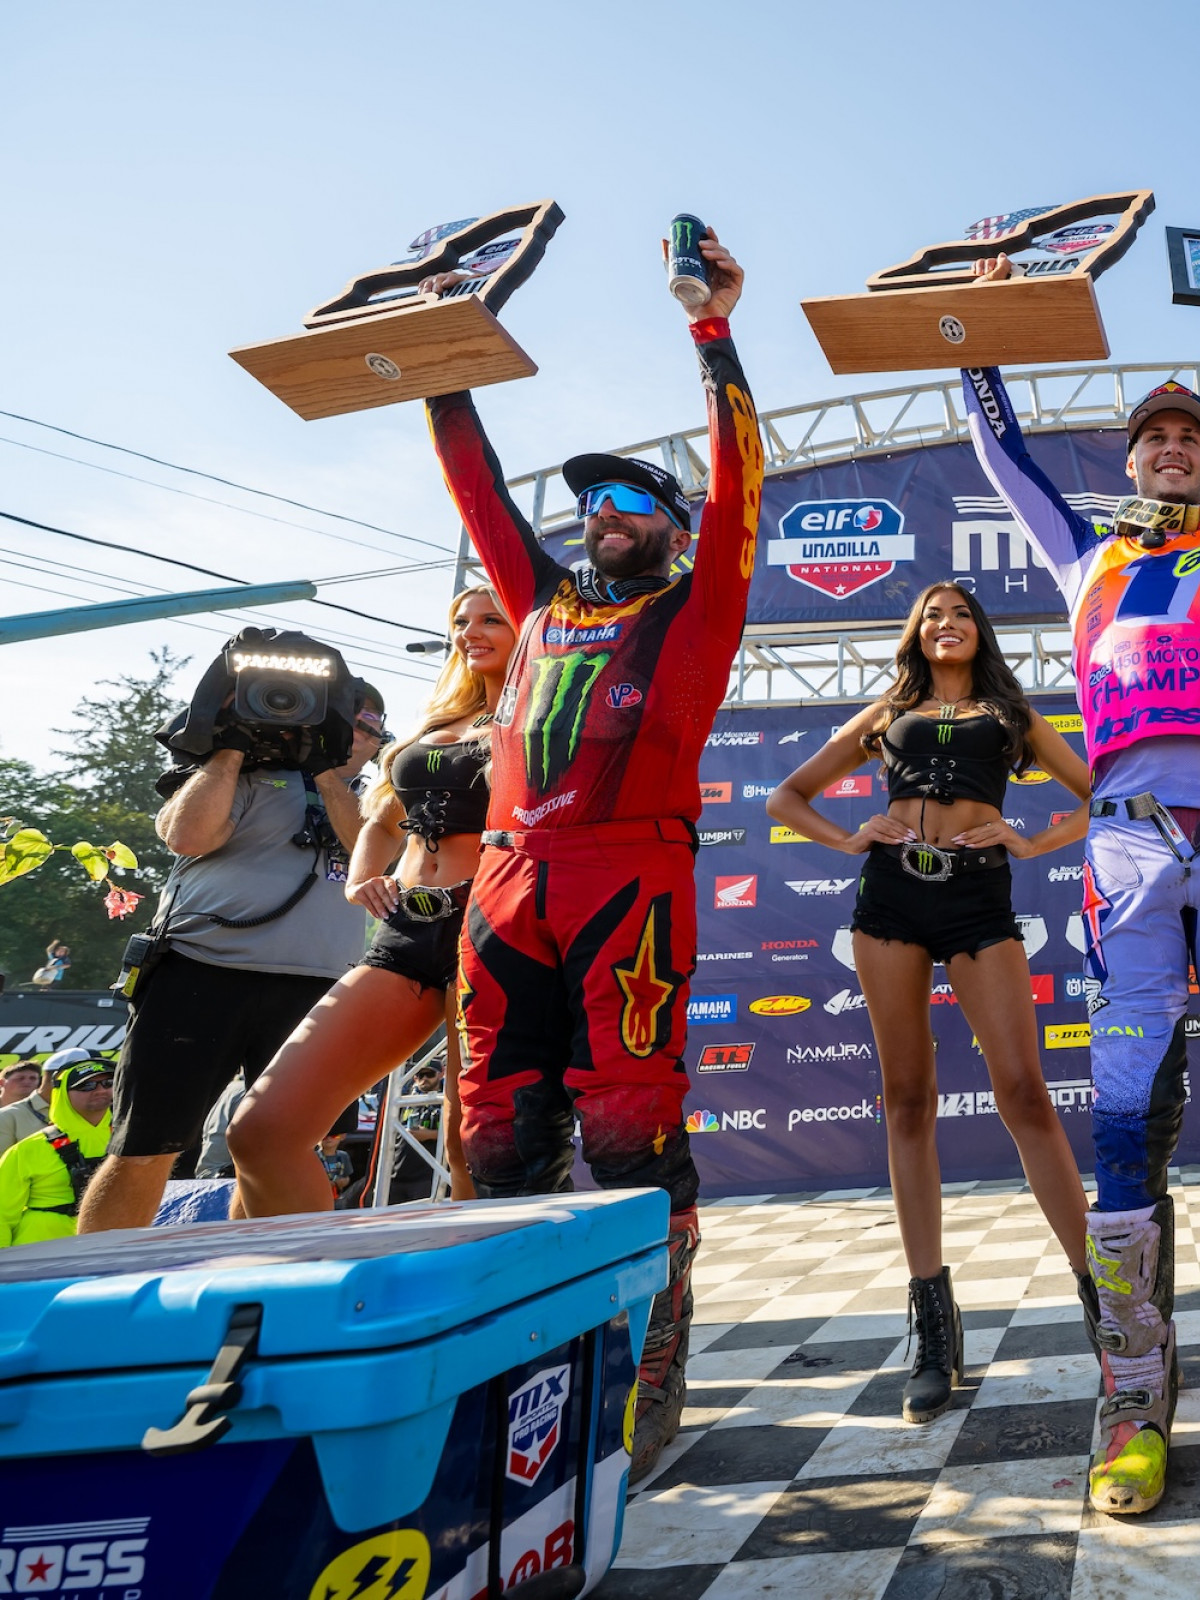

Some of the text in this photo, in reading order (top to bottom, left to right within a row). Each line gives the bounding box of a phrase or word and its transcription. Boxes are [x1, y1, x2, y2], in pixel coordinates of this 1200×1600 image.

[968, 368, 1006, 439] ONDA
[801, 509, 852, 531] elf
[802, 541, 880, 558] UNADILLA
[801, 564, 882, 574] NATIONAL
[561, 626, 617, 642] YAMAHA
[1089, 662, 1113, 688] 2025
[1115, 652, 1142, 671] 450
[723, 731, 760, 739] MOUNTAIN
[512, 790, 579, 828] PROGRESSIVE
[797, 879, 856, 892] FLY
[761, 939, 819, 950] HONDA
[697, 952, 753, 961] MARINES
[771, 954, 808, 962] Generators
[753, 997, 812, 1015] FMF
[702, 1045, 754, 1064] ETS
[787, 1042, 871, 1061] NAMURA
[727, 1063, 746, 1071] FUELS
[721, 1109, 766, 1131] NBC
[788, 1099, 874, 1131] peacock
[509, 1367, 568, 1424] MX
[514, 1407, 558, 1442] PRO RACING
